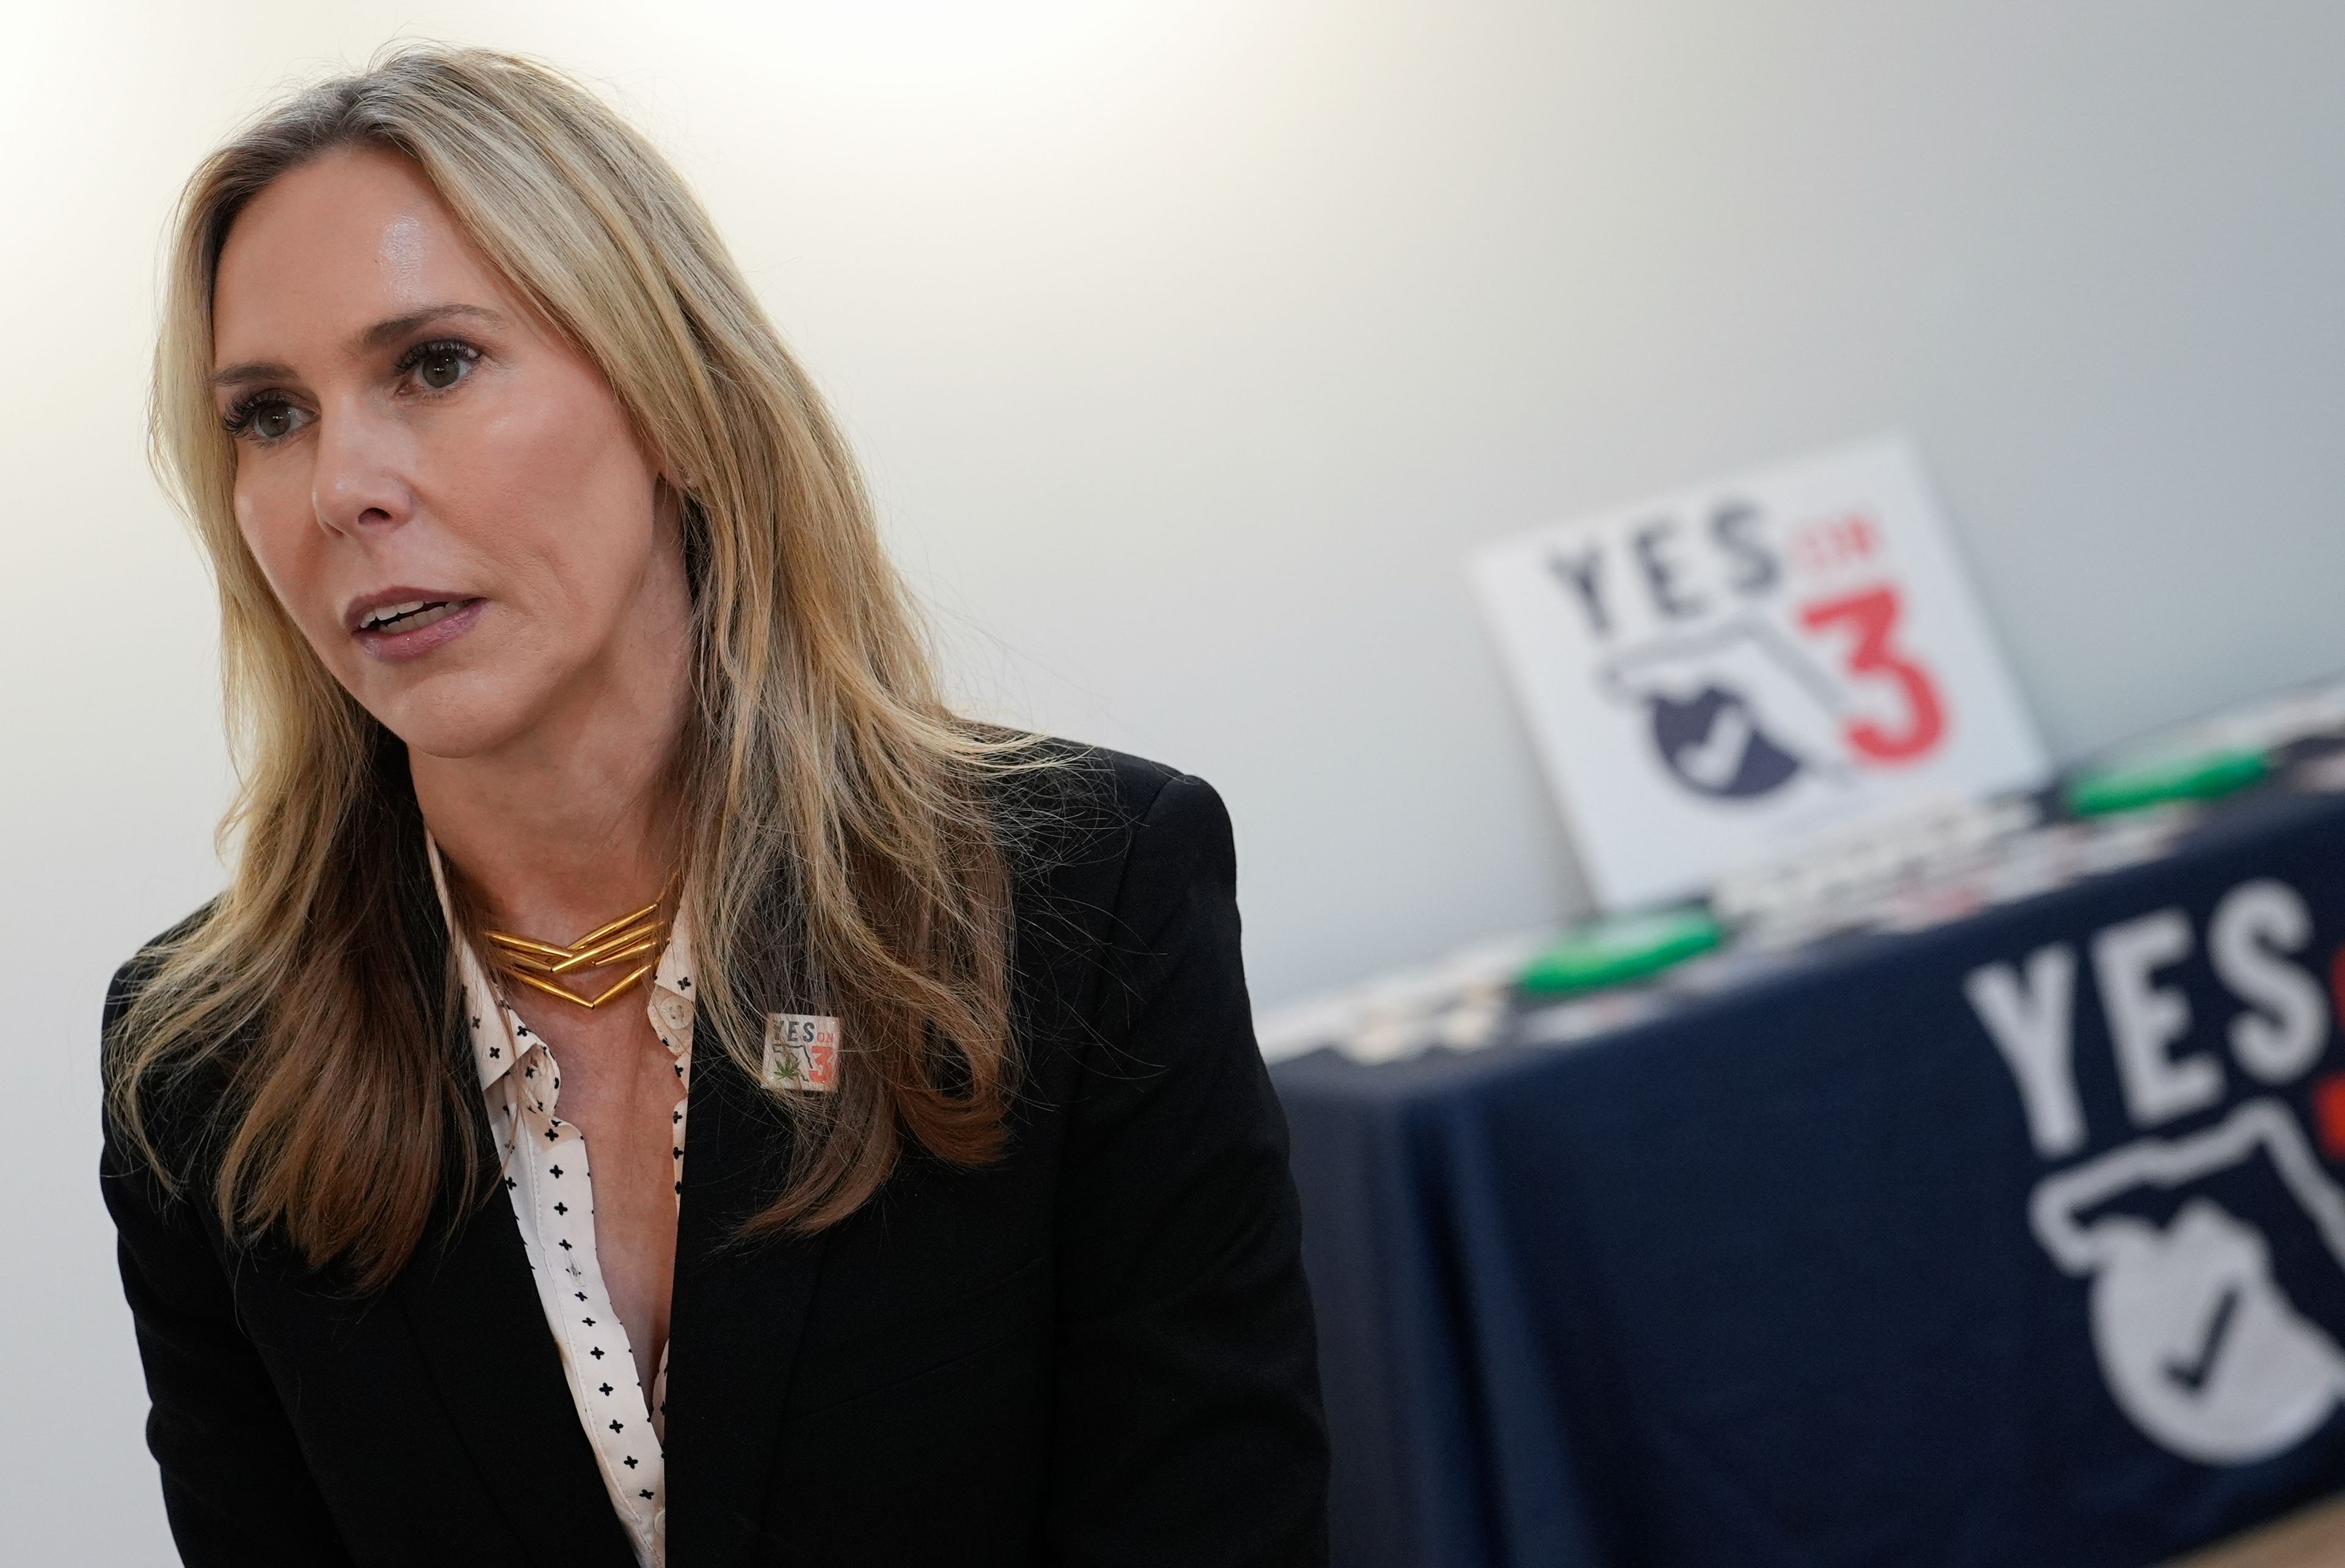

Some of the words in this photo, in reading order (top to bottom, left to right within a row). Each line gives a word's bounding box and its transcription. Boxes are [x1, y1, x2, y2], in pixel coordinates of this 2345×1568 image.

[1548, 498, 1782, 637] YES
[1798, 581, 1949, 768] 3
[773, 1020, 815, 1043] YES
[817, 1032, 834, 1043] ON
[809, 1046, 834, 1084] 3
[1963, 879, 2329, 1158] YES
